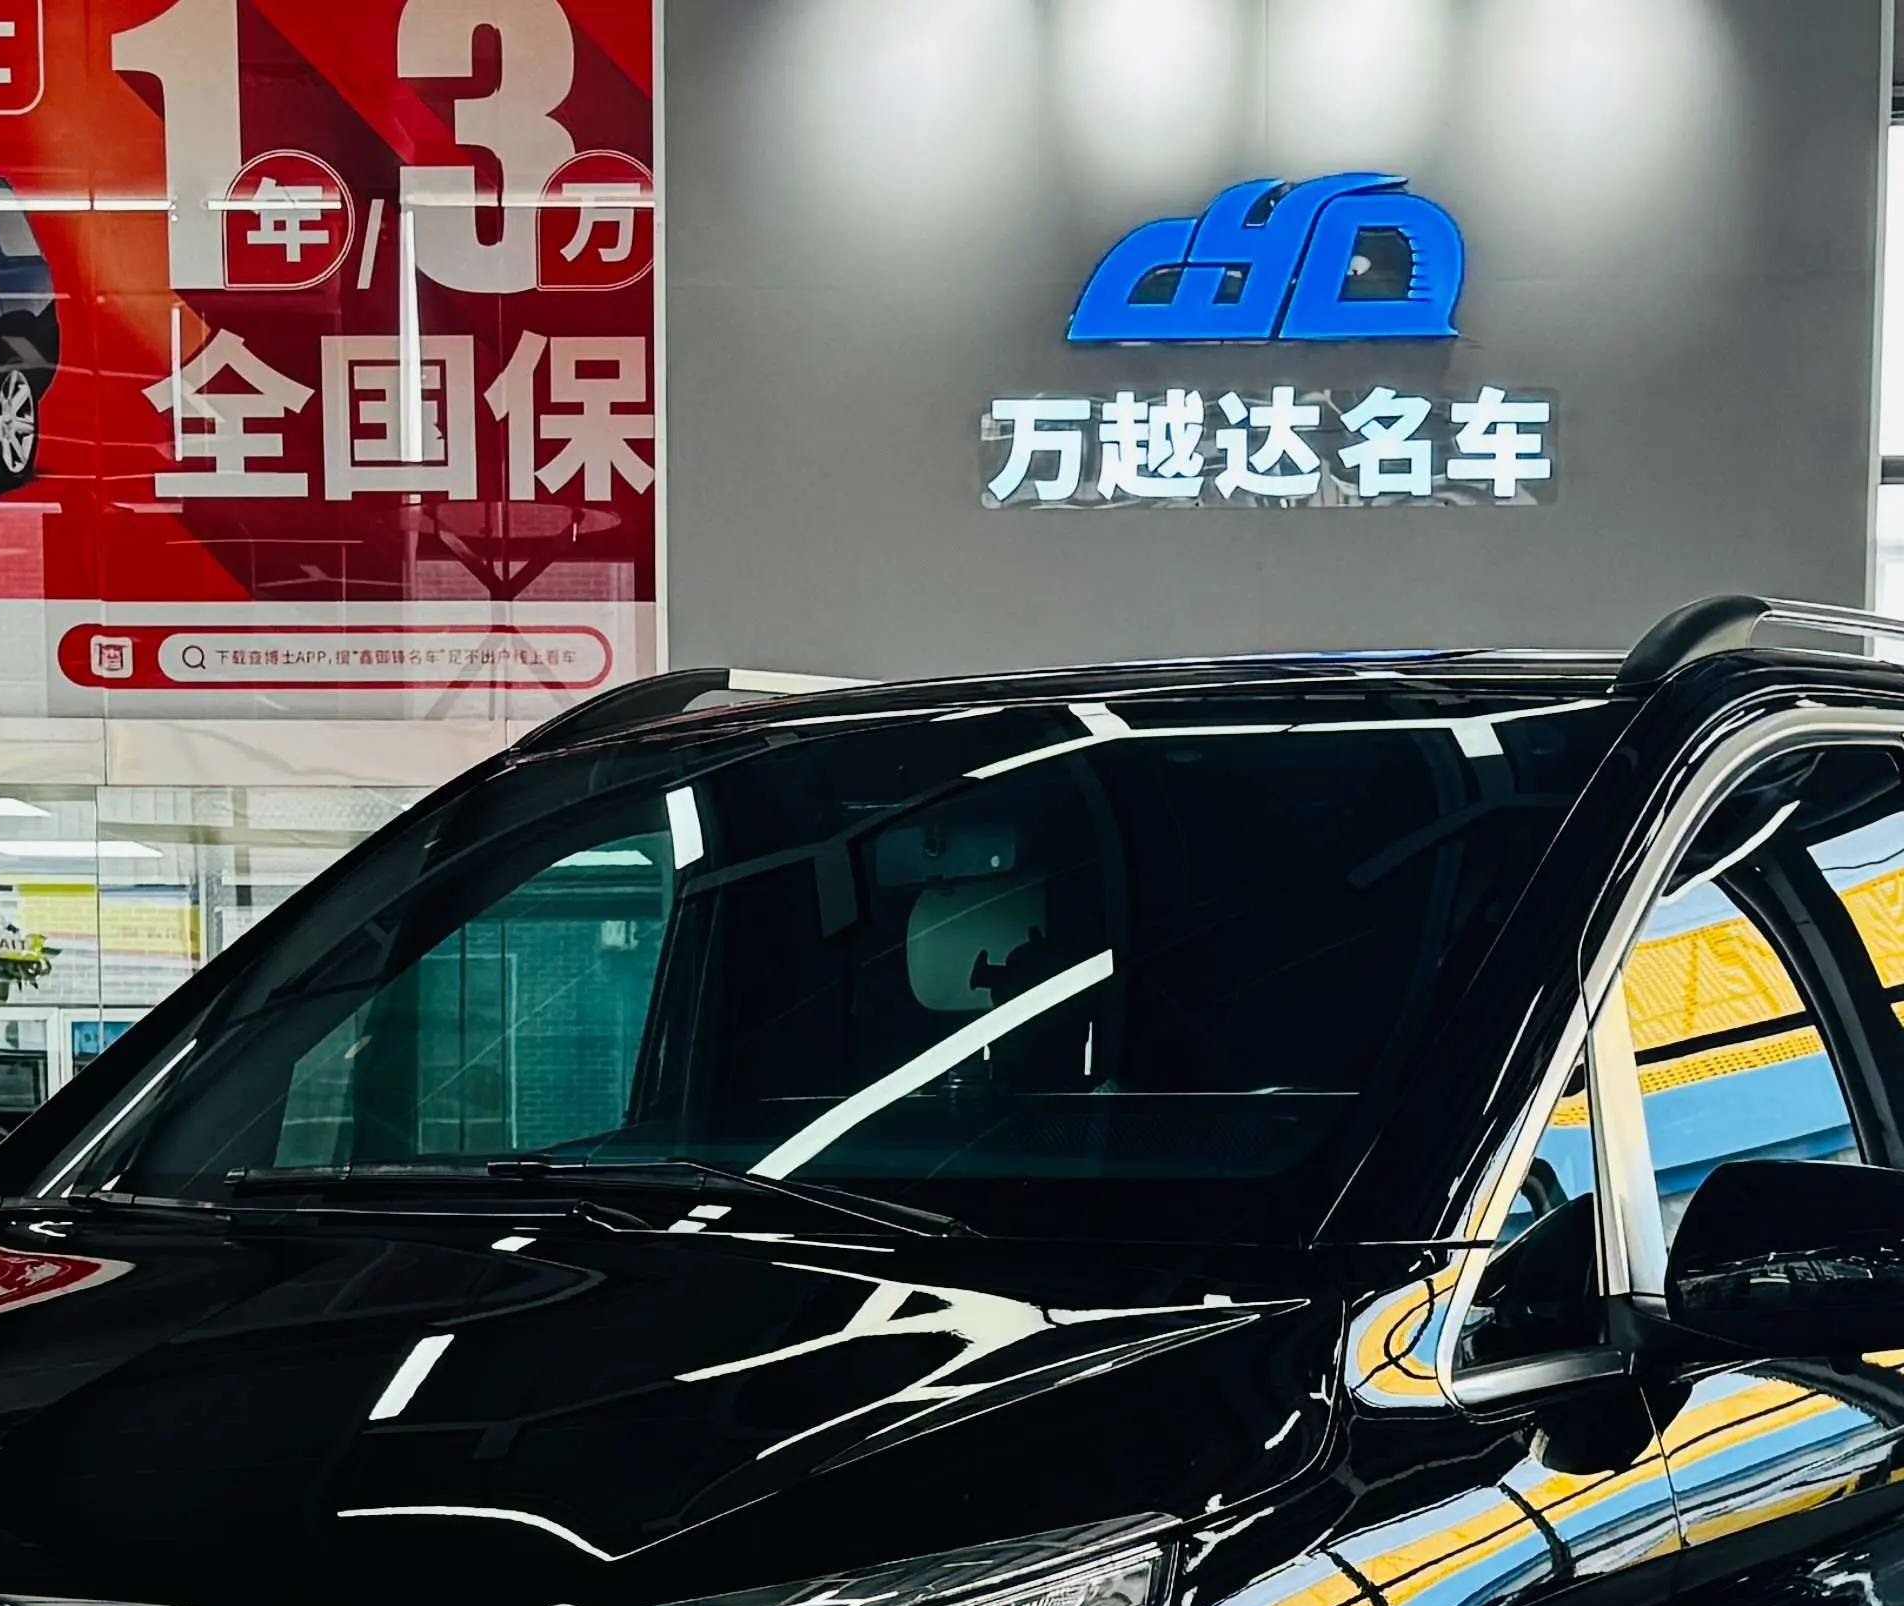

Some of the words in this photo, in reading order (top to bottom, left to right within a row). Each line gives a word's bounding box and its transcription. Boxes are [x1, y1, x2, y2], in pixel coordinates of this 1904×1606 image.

[141, 328, 655, 501] 全国保
[988, 386, 1552, 502] 万越达名车
